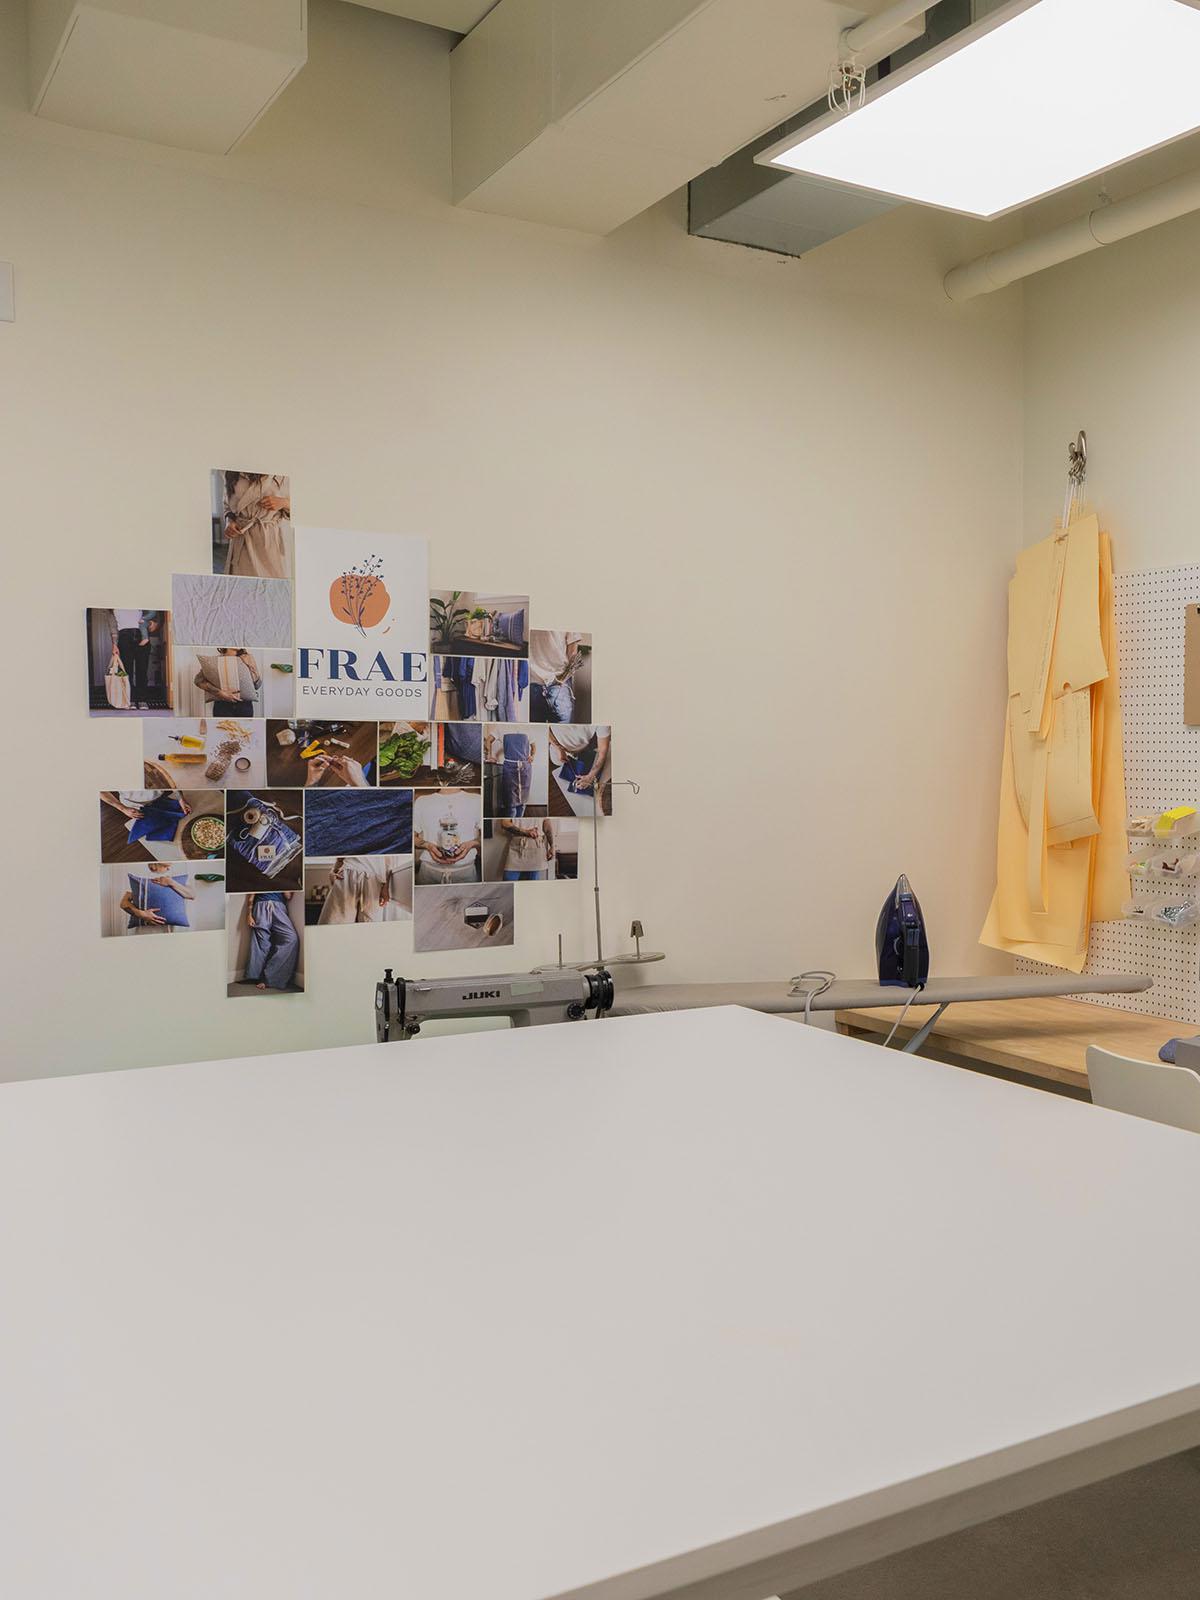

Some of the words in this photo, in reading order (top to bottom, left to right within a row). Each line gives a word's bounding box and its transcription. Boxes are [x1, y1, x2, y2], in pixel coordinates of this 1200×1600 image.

[298, 648, 427, 682] FRAE
[302, 686, 370, 696] EVERYDAY
[376, 688, 422, 698] GOODS
[462, 990, 500, 1000] JUKI
